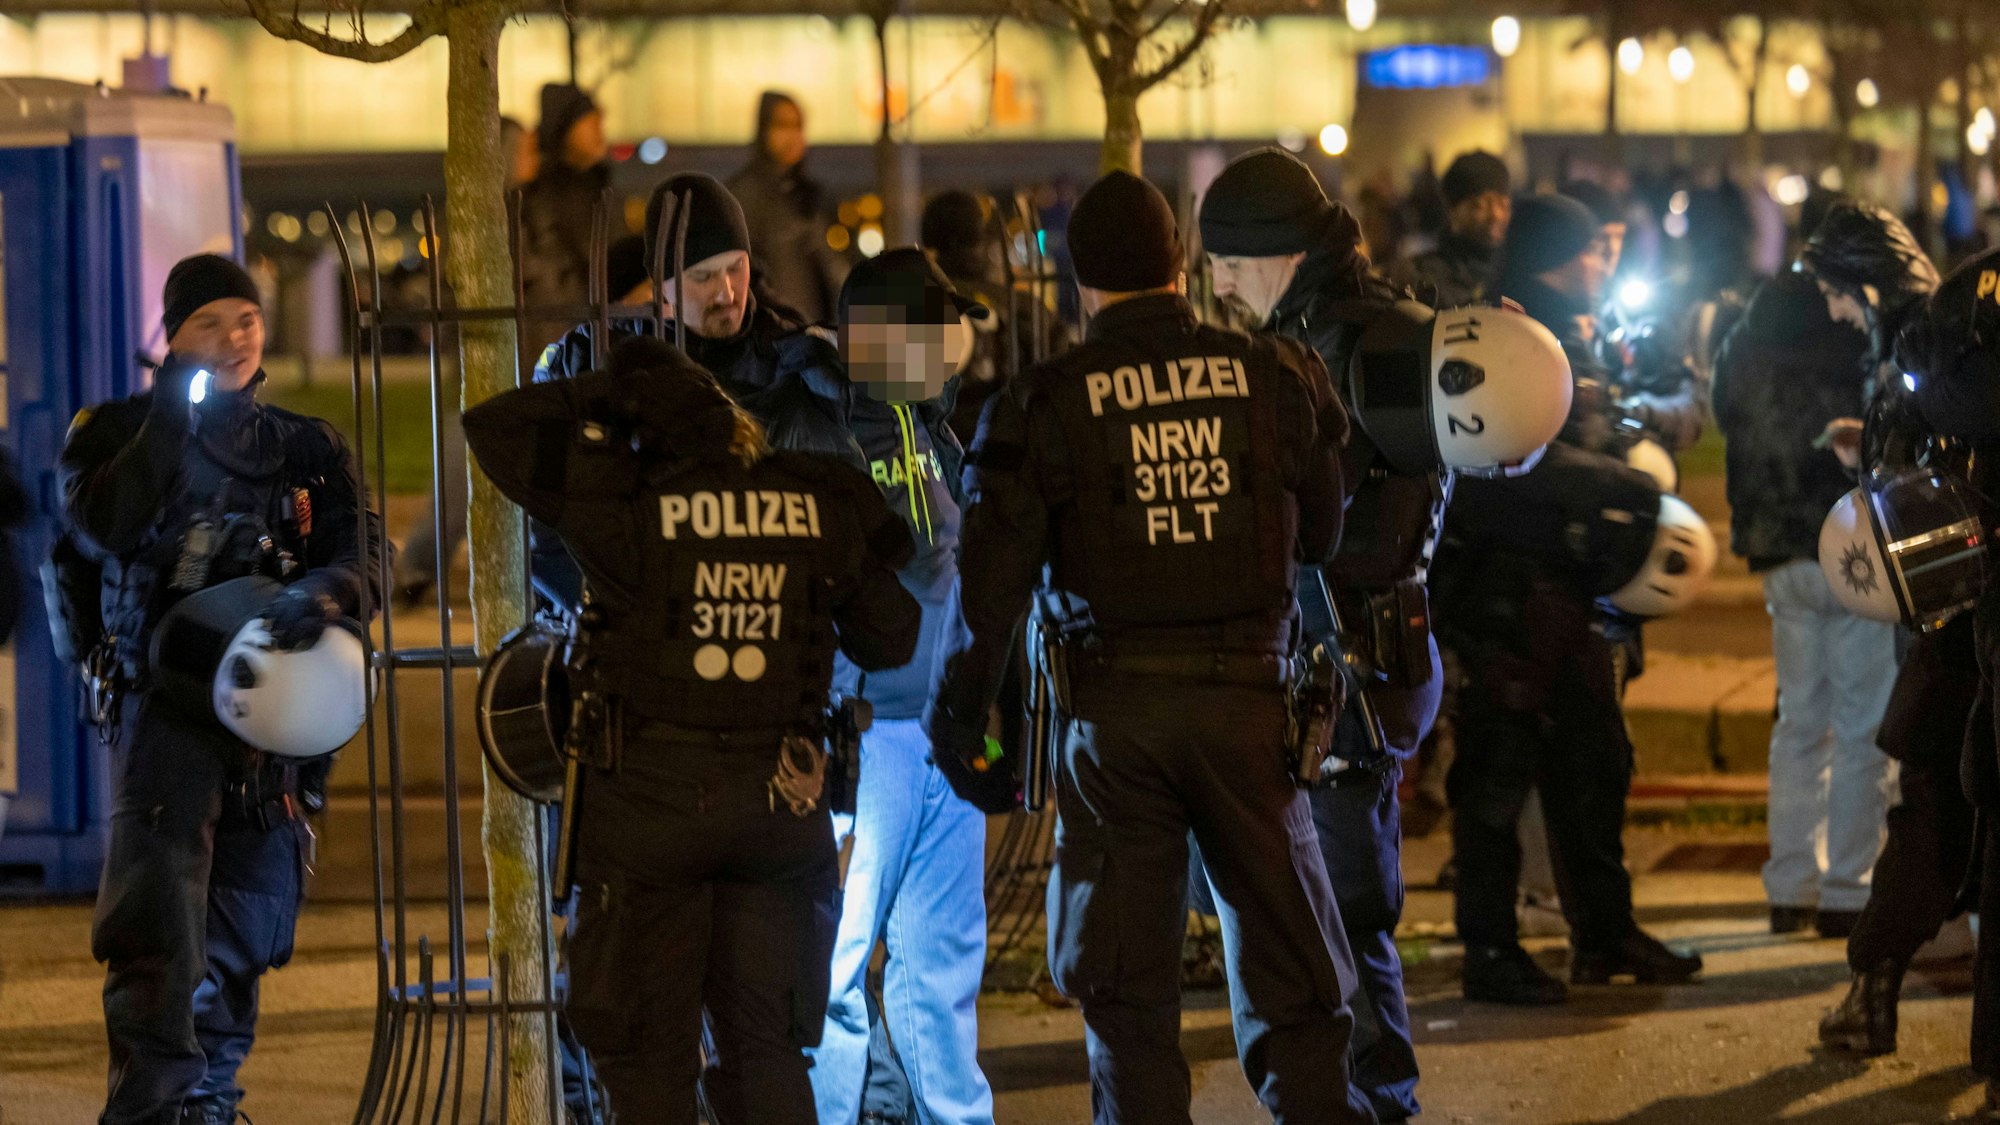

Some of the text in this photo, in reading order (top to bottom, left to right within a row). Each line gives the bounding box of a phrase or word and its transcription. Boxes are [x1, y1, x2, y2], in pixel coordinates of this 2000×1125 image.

[1976, 269, 2000, 307] P
[1085, 356, 1250, 417] POLIZEI
[1130, 416, 1222, 463] NRW
[1447, 413, 1485, 439] 2
[1134, 457, 1231, 502] 31123
[659, 490, 822, 540] POLIZEI
[1147, 502, 1219, 546] FLT
[694, 561, 787, 600] NRW
[691, 602, 782, 640] 31121
